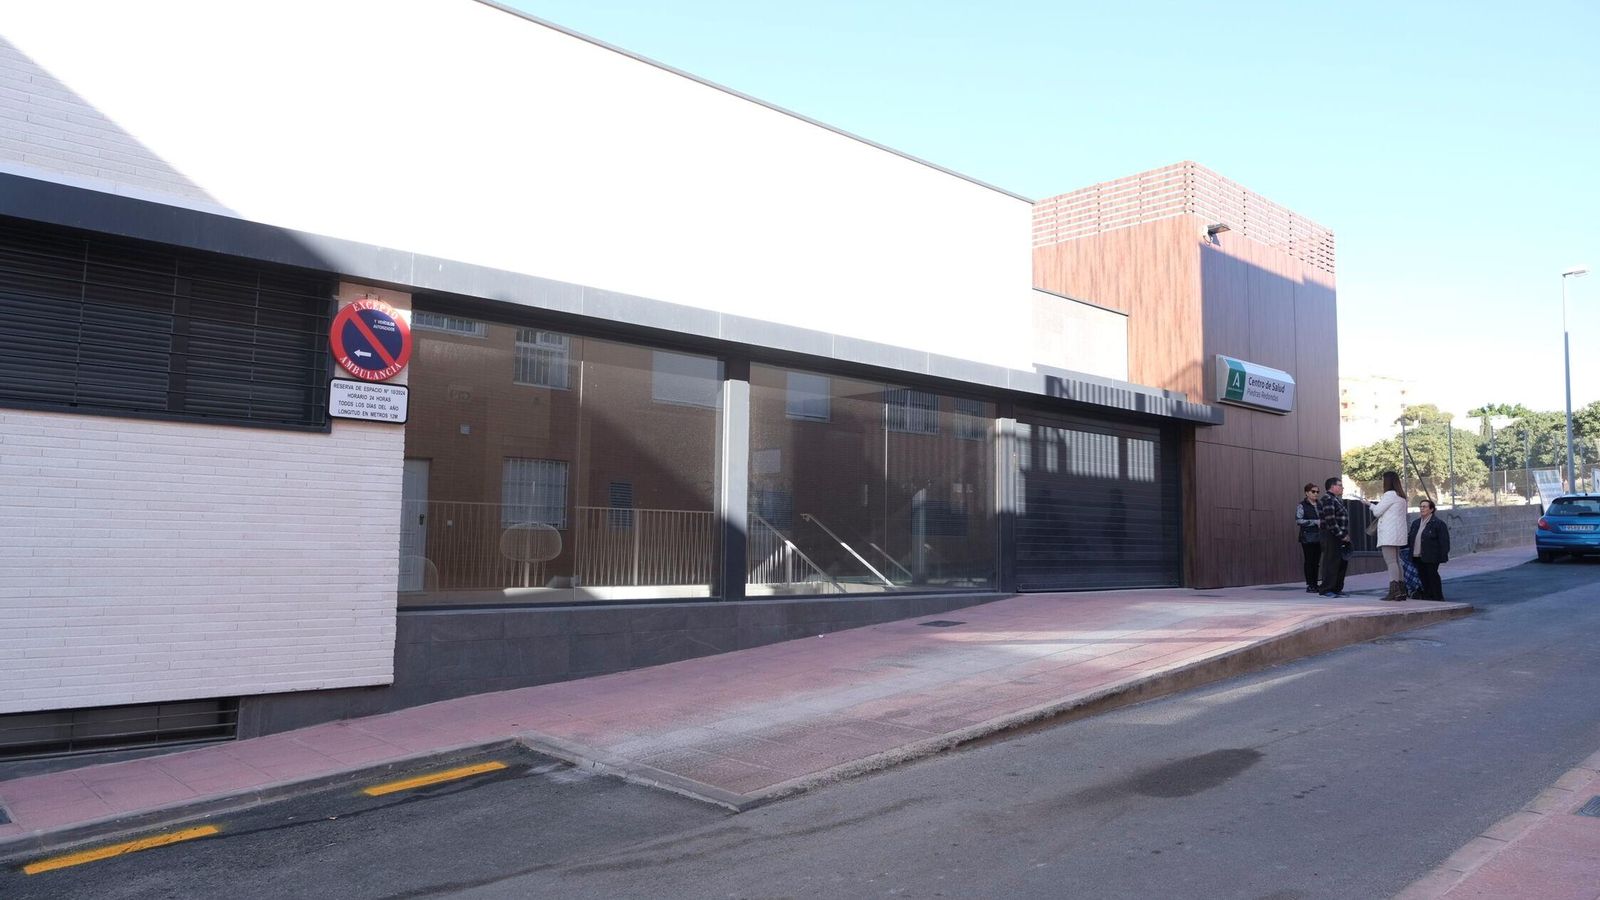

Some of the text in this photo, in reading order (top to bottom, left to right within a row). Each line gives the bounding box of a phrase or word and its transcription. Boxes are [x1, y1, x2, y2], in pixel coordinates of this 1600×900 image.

[352, 301, 398, 319] EXCEPTO
[340, 356, 402, 380] AMBULANCIA
[333, 382, 354, 390] RESERVA
[363, 385, 382, 394] ESPACIO
[1248, 376, 1265, 389] Centro
[1265, 381, 1272, 391] de
[1272, 382, 1286, 394] Salud
[1247, 389, 1261, 398] Piedras
[337, 408, 360, 416] LONGITUD
[370, 411, 388, 419] METROS
[389, 404, 399, 412] AÑO
